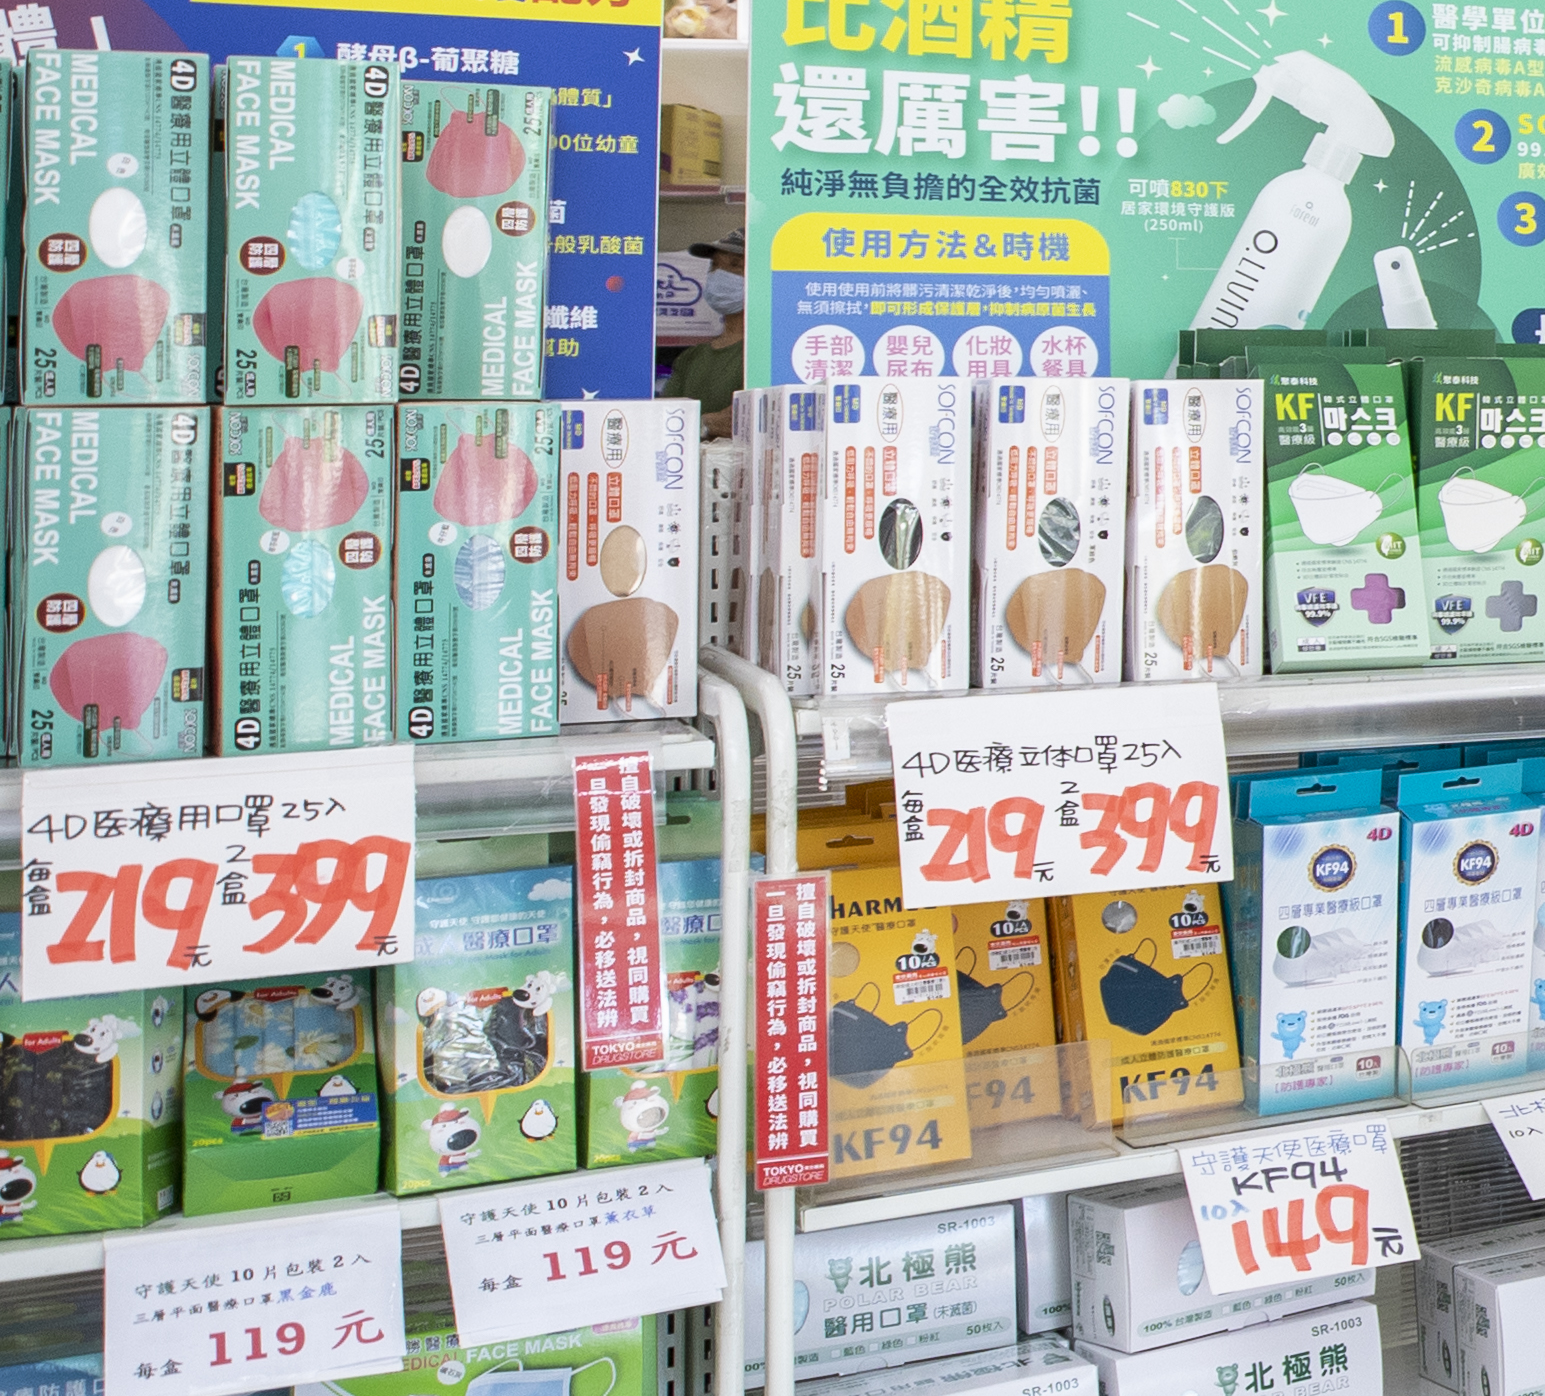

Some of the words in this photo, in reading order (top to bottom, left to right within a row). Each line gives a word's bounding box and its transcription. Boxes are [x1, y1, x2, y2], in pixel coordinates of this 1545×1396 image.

[1387, 12, 1408, 44] 1
[70, 53, 98, 165] MEDICAL
[771, 62, 1139, 162] 還厲害!!
[1472, 120, 1495, 153] 2
[33, 127, 61, 205] MASK
[781, 168, 1101, 205] 純淨無負擔的全效抗菌
[1128, 178, 1228, 199] 可噴830下
[1120, 201, 1235, 218] 居家環境守護版
[1143, 216, 1203, 233] (250ml)
[1514, 203, 1537, 235] 3
[821, 228, 1071, 261] 使用方法&時機
[805, 335, 853, 355] 手部
[886, 335, 933, 355] 嬰兒
[1042, 336, 1087, 355] 水杯
[1275, 393, 1315, 421] KF
[1324, 407, 1397, 431] 마스크
[529, 587, 555, 657] MASK
[1305, 610, 1331, 619] 99.9%
[498, 627, 525, 735] MEDICAL
[529, 662, 555, 734] FACE
[408, 706, 434, 740] 4D
[920, 796, 1046, 884] 219
[1079, 781, 1220, 877] 399
[1315, 861, 1349, 877] KF94
[1460, 856, 1492, 872] KF94
[46, 858, 219, 970] 219
[243, 835, 412, 953] 399
[591, 1049, 656, 1066] DRUGSTORE
[592, 1042, 635, 1055] TOKYO
[1118, 1063, 1220, 1104] KF94
[832, 1119, 943, 1164] KF94
[763, 1165, 803, 1179] TOKYO
[764, 1170, 825, 1186] DRUGSTORE
[1232, 1157, 1348, 1195] KF94
[937, 1215, 996, 1234] SR-1003
[1231, 1183, 1370, 1276] 149
[478, 1273, 523, 1294] 每盒
[542, 1240, 634, 1281] 119
[651, 1229, 699, 1265] 元
[859, 1242, 978, 1288] 北極熊
[823, 1287, 904, 1312] POLAR
[915, 1275, 979, 1296] BEAR
[824, 1303, 928, 1339] 醫用口罩
[134, 1357, 183, 1380] 每盒
[208, 1321, 306, 1367] 119
[332, 1309, 384, 1348] 元
[1245, 1342, 1350, 1392] 北極熊
